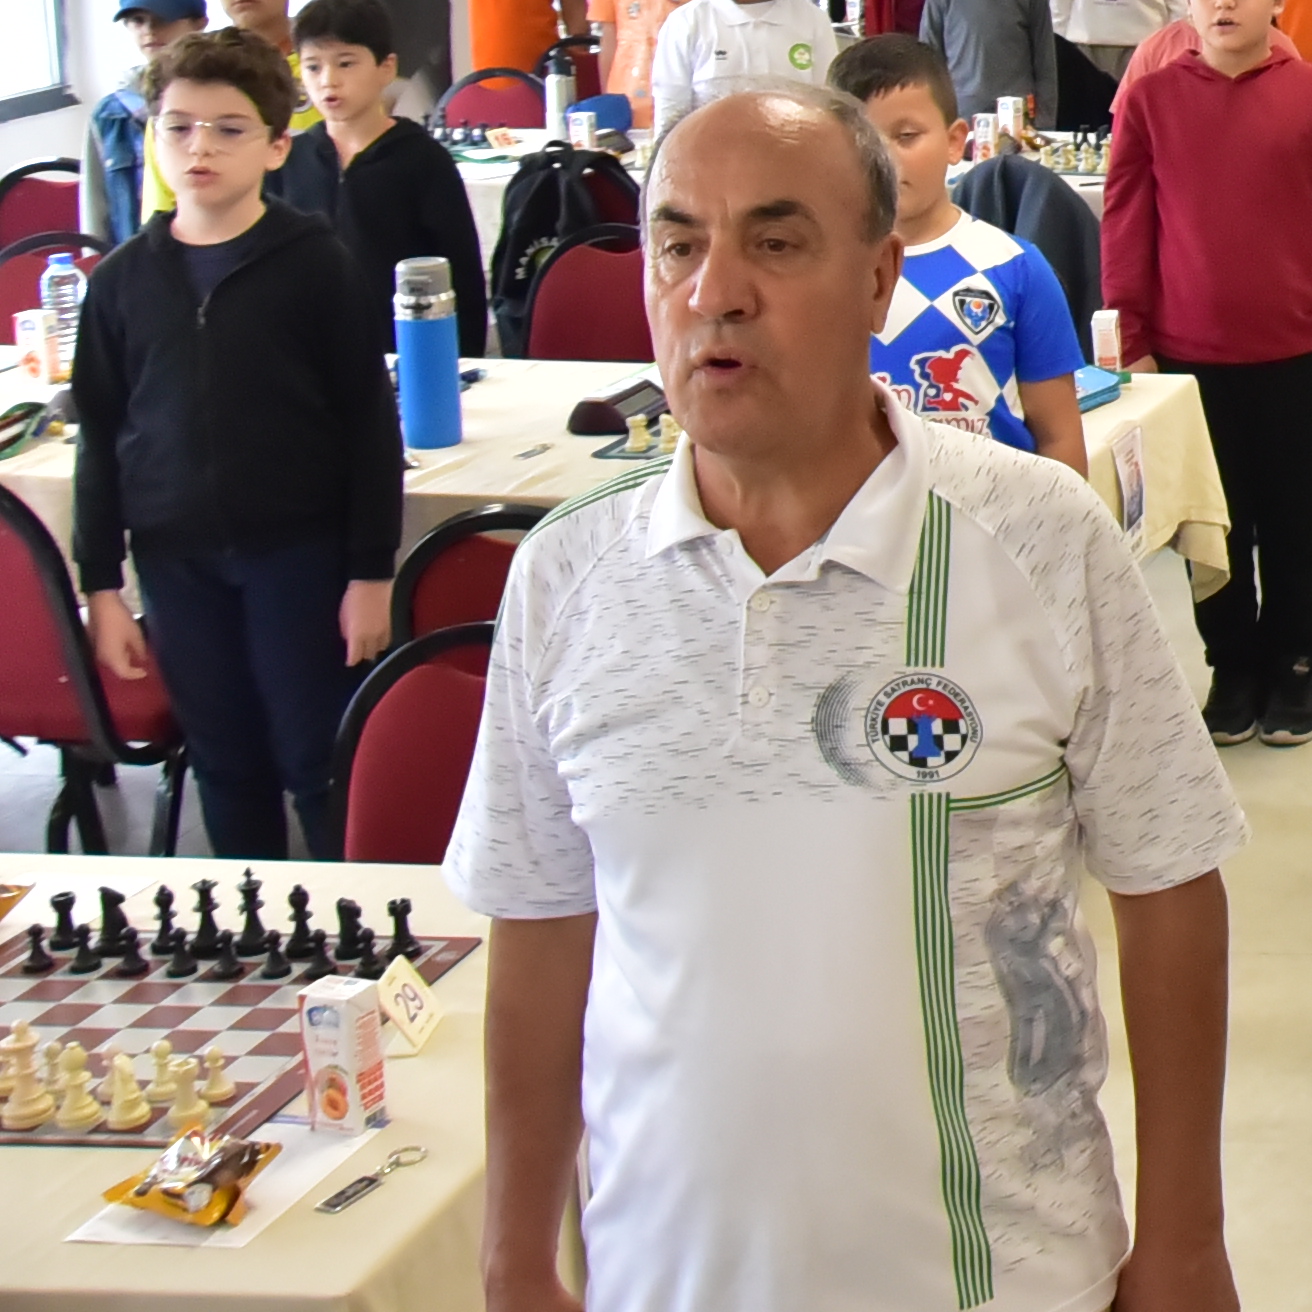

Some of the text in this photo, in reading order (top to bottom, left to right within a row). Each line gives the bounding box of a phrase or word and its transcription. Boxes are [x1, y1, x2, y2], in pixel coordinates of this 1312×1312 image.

[868, 676, 979, 744] TÜRKİYE SATRANÇ FEDERASYONU
[916, 770, 940, 780] 1991
[393, 982, 424, 1024] 29
